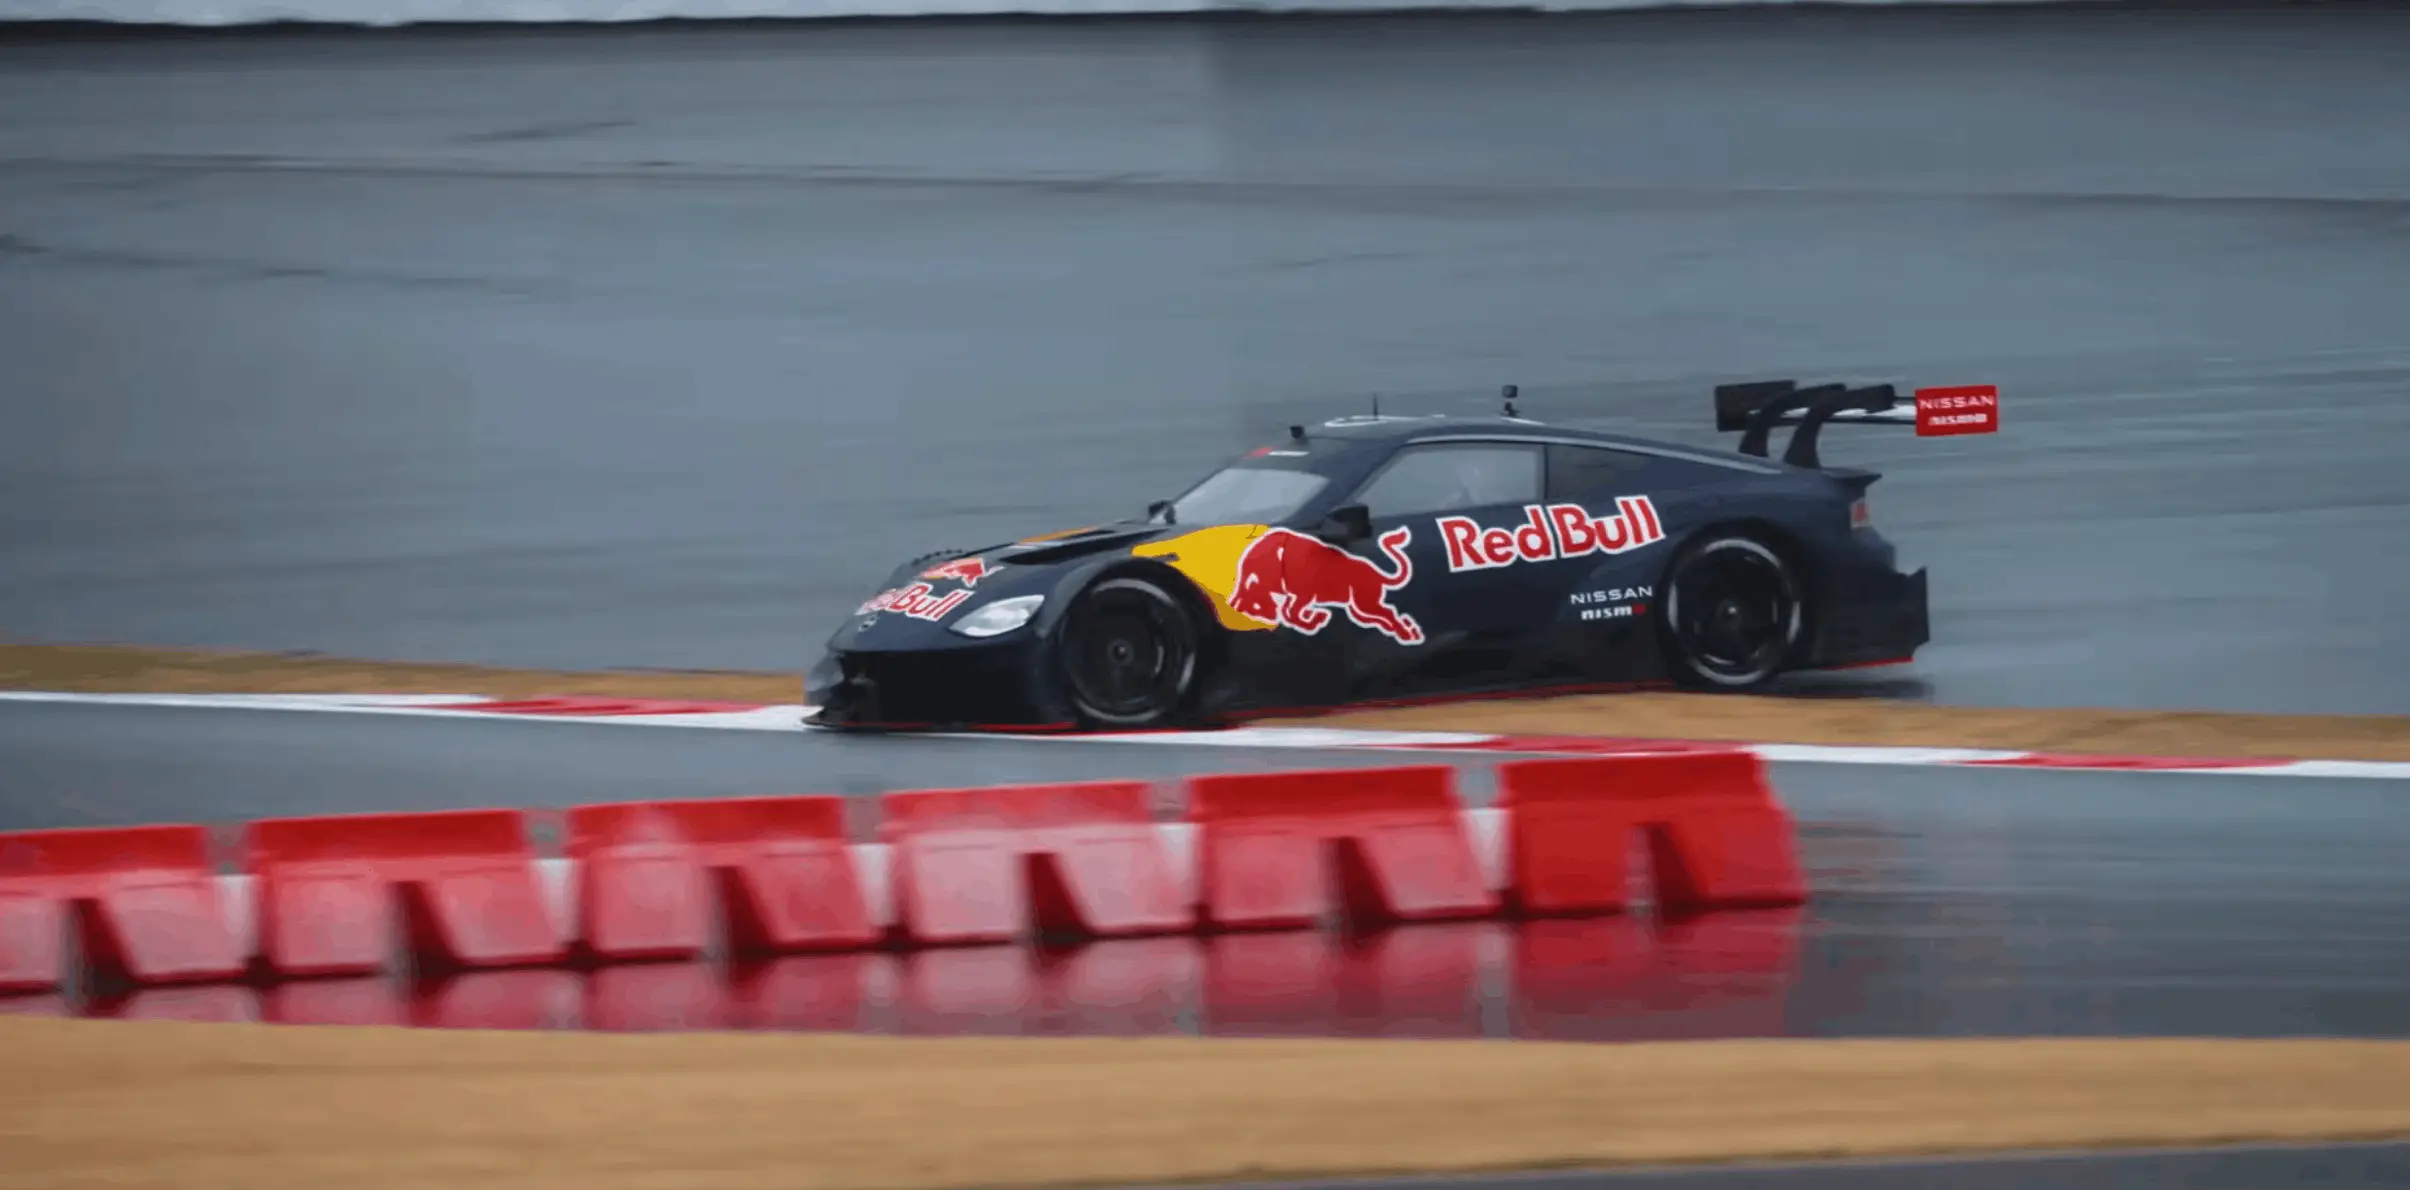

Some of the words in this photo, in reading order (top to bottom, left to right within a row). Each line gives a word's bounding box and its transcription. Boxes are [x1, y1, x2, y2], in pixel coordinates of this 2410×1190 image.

[1919, 395, 1994, 409] NISSAN
[1438, 506, 1555, 571] Red
[1548, 496, 1664, 557] Bull
[1570, 585, 1653, 605] NISSAN
